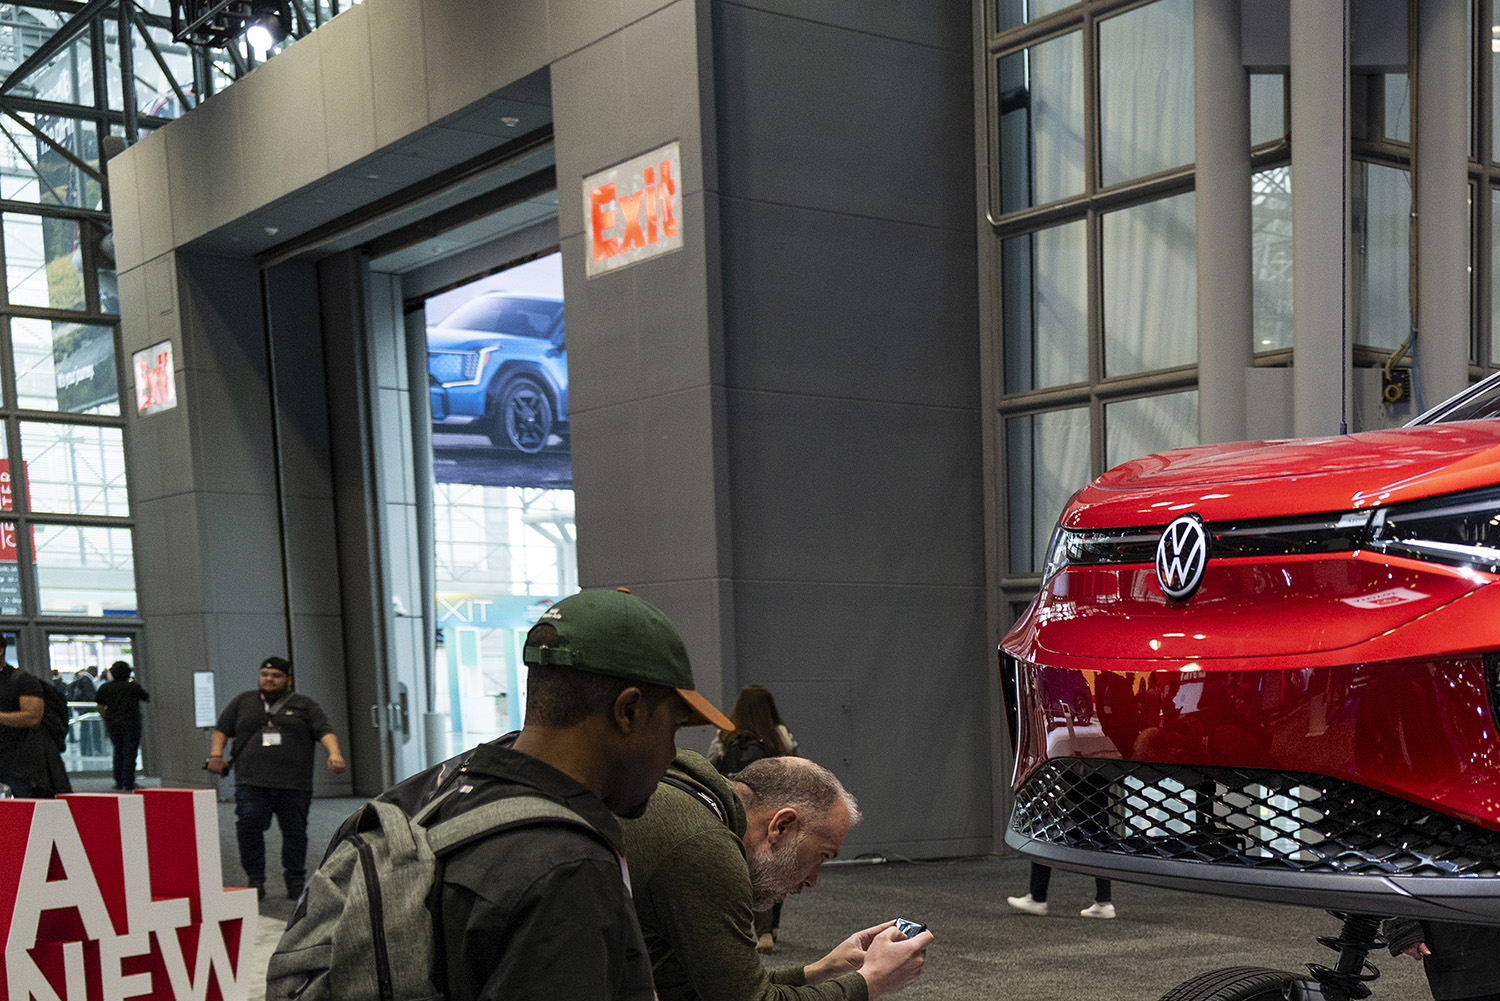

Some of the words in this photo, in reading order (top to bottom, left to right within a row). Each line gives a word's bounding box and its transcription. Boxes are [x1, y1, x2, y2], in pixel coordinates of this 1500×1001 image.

[589, 160, 677, 262] Exit
[135, 352, 169, 410] Exit
[439, 600, 493, 622] XIT
[5, 789, 259, 950] ALL
